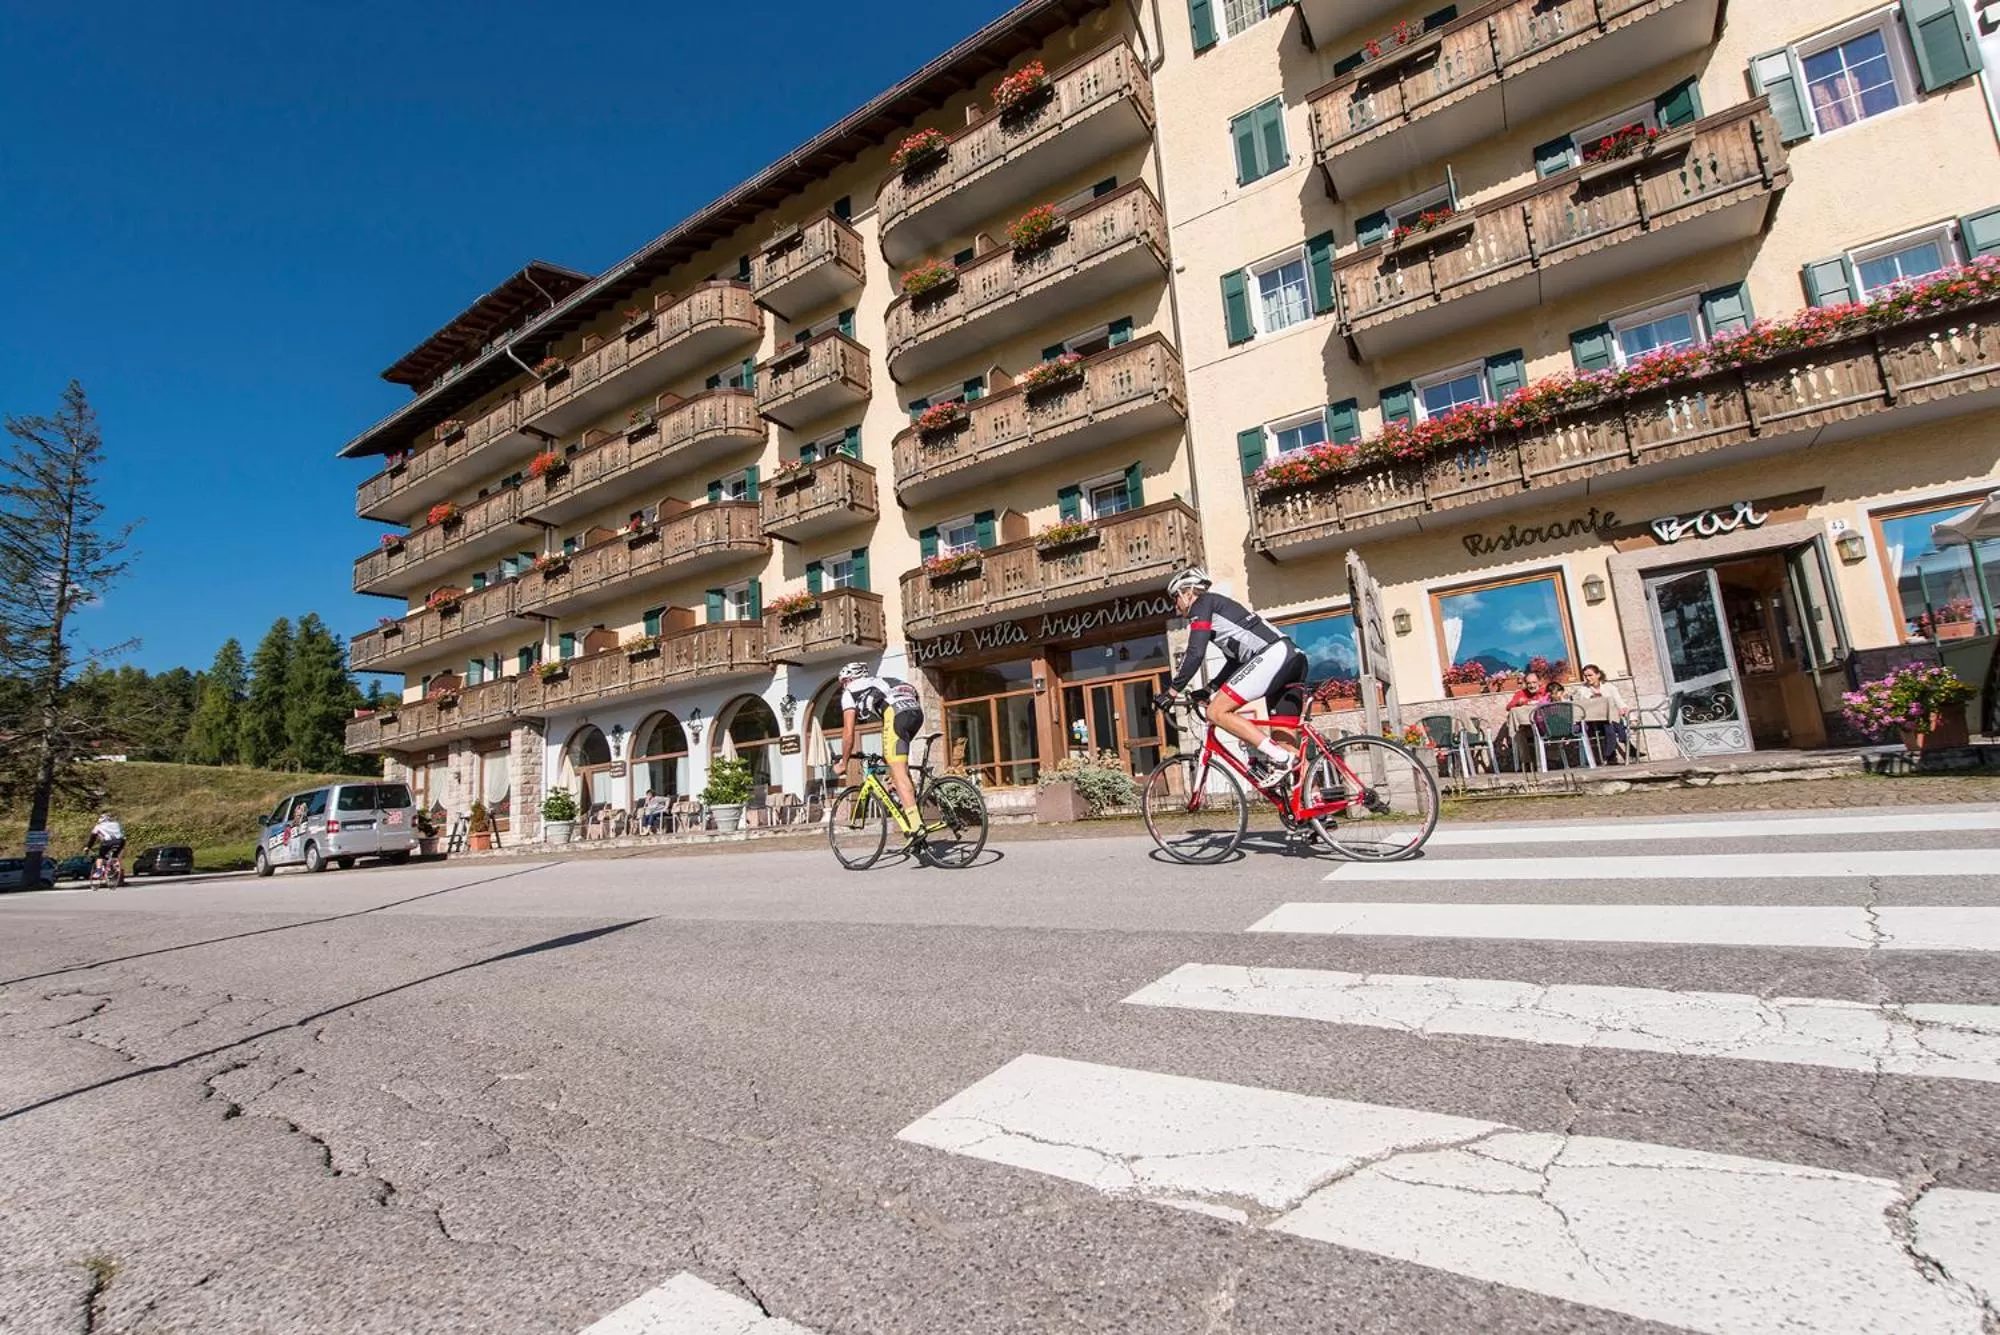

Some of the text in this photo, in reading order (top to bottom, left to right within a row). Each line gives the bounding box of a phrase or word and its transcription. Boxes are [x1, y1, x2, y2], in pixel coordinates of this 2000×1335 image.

[1462, 507, 1622, 557] Ristorante
[1650, 500, 1769, 543] Bar
[911, 597, 1174, 661] Hotel Villa Argentina
